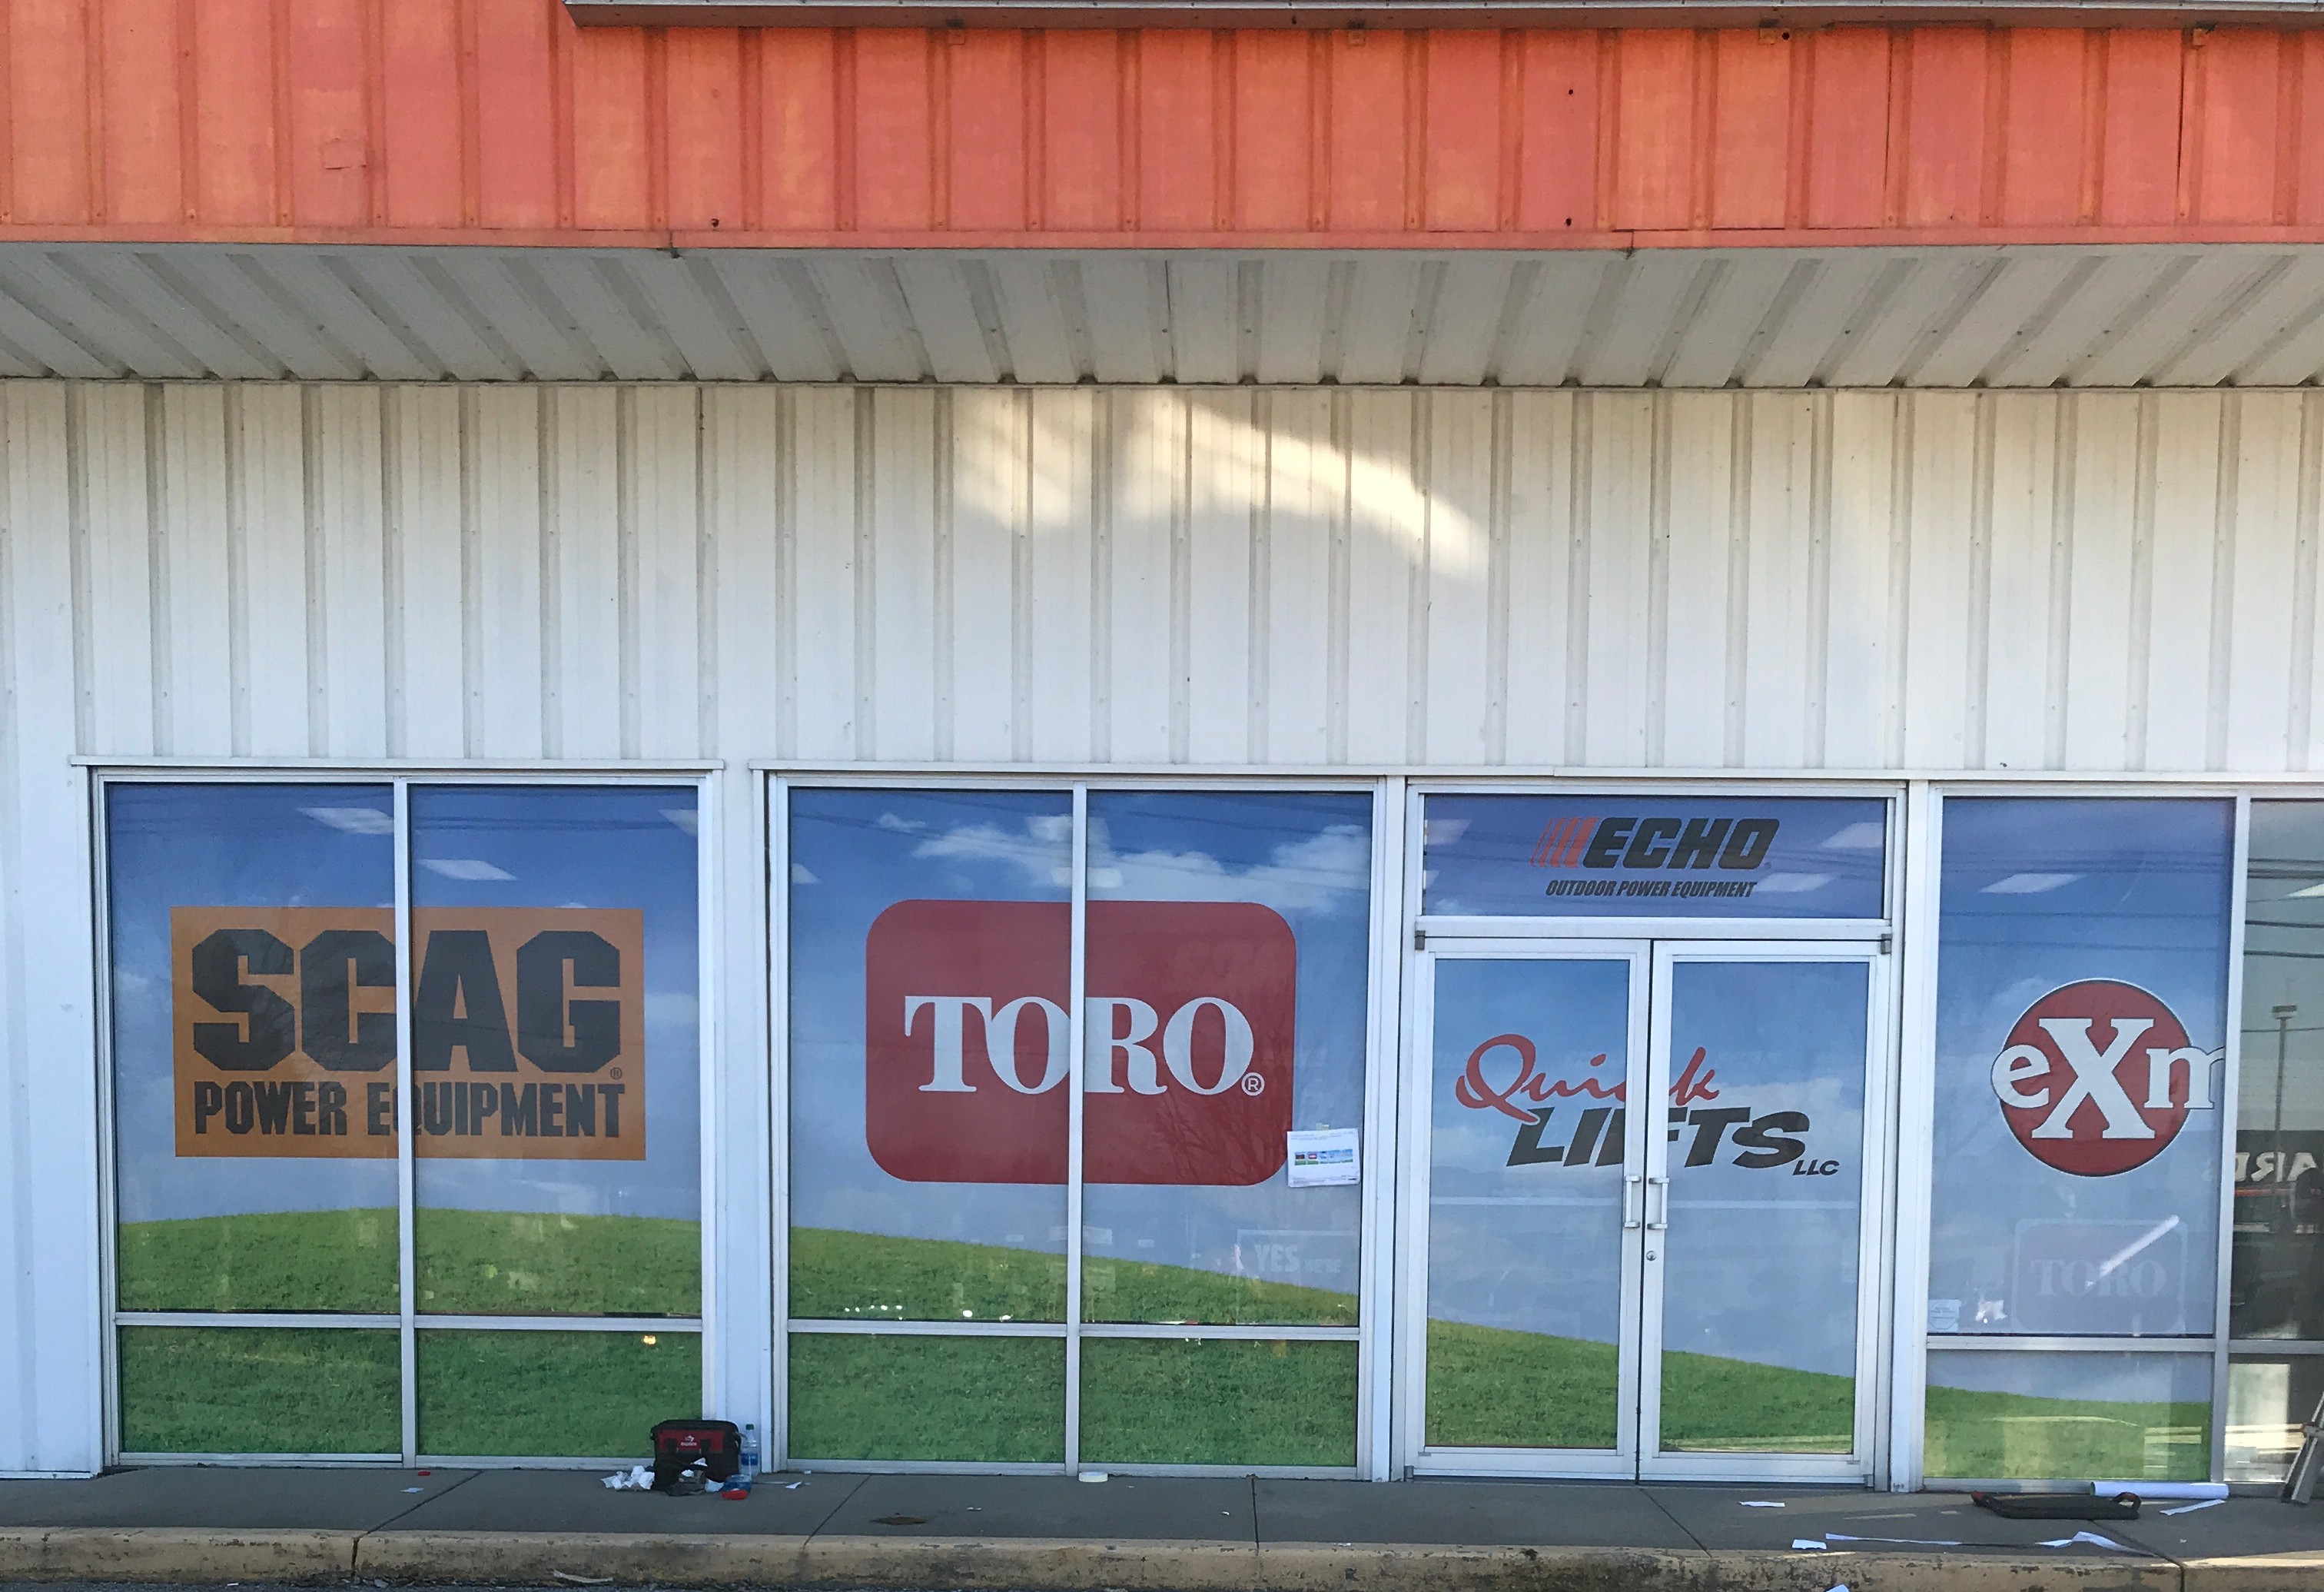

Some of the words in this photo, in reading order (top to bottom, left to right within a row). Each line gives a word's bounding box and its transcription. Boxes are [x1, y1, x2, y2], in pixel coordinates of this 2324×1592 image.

[1582, 817, 1780, 869] ECHO
[1545, 879, 1615, 896] OUTDOOR
[1615, 880, 1671, 897] POWER
[1671, 881, 1758, 899] EQUIPMENT
[194, 1081, 347, 1136] POWER
[1792, 1158, 1840, 1176] LLC
[1254, 1243, 1299, 1273] YES
